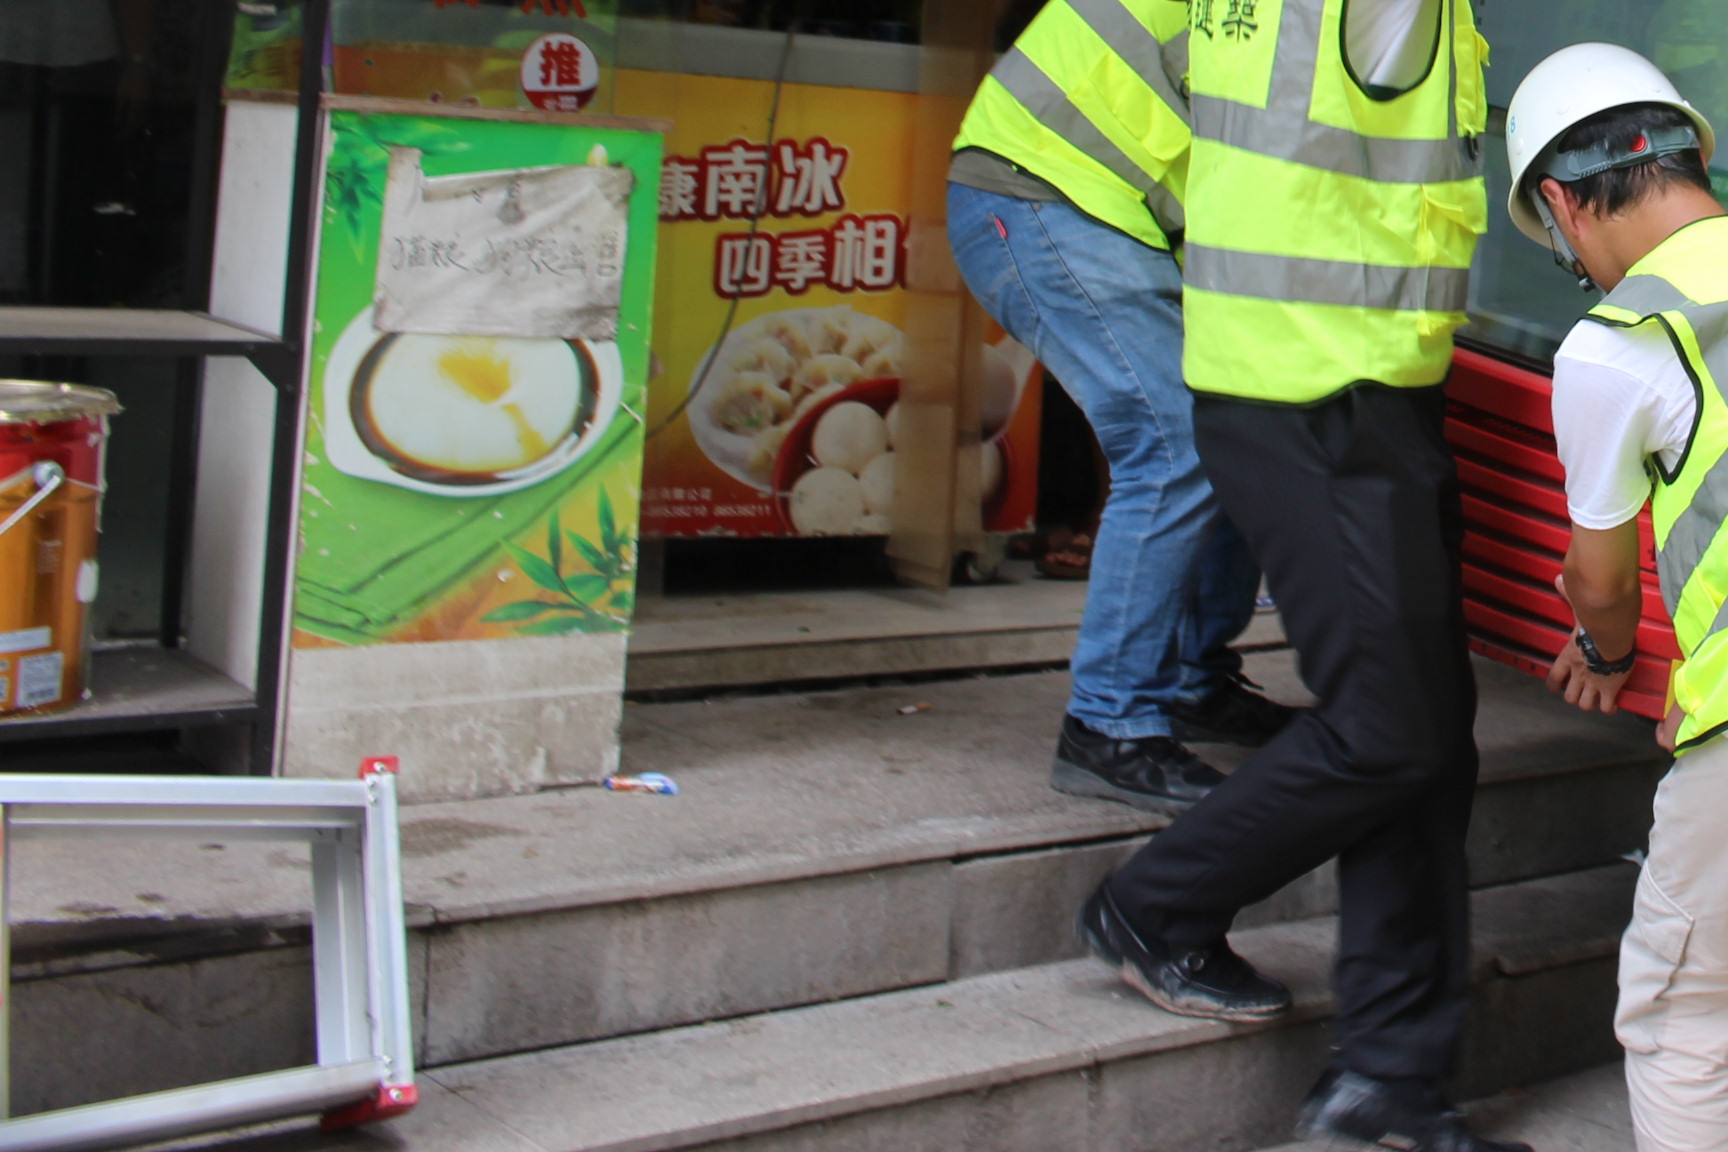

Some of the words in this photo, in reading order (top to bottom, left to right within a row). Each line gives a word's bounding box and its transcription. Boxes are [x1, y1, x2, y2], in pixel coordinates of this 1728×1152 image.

[539, 40, 582, 87] 推
[719, 218, 905, 294] 四季相
